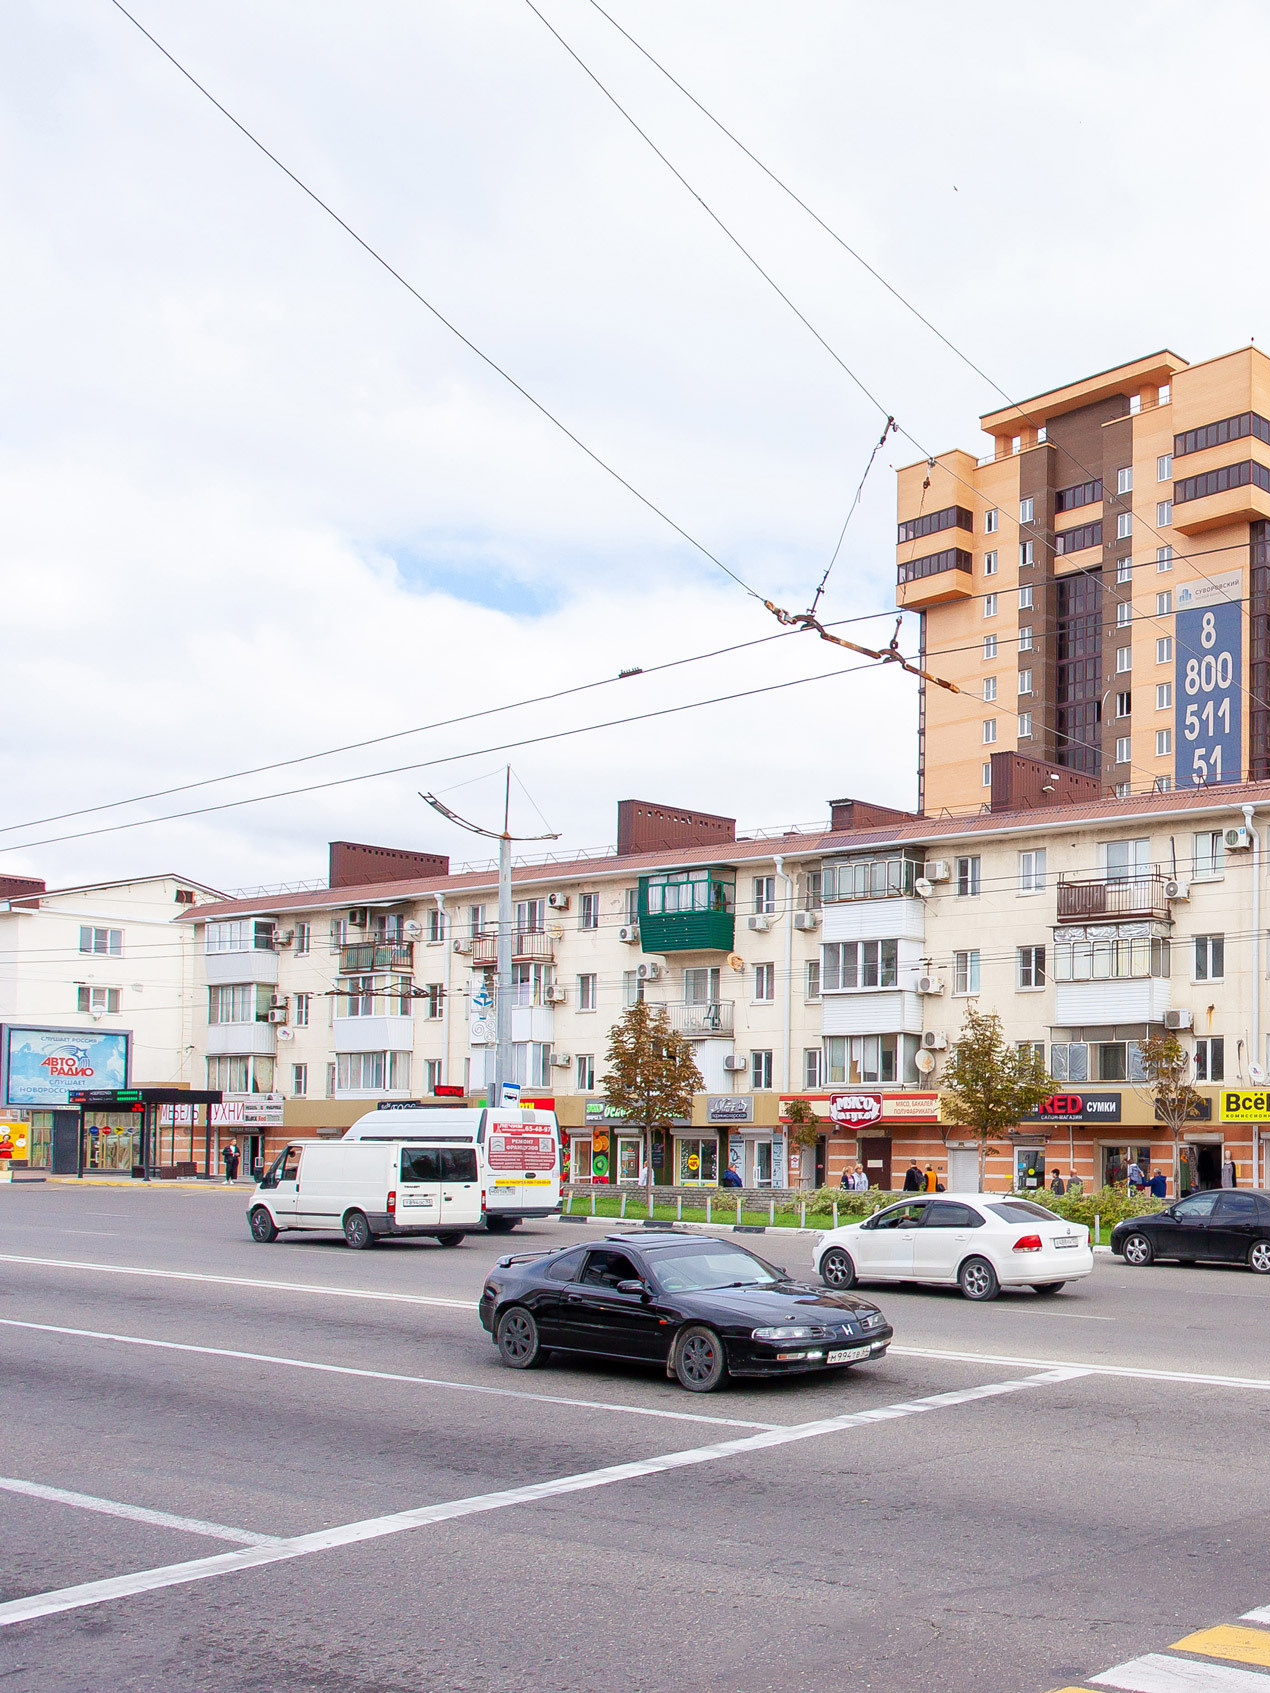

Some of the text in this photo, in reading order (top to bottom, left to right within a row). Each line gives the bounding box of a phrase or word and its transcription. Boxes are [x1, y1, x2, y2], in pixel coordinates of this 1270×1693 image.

[1201, 611, 1216, 649] 8
[1185, 651, 1232, 695] 800
[1184, 697, 1230, 741] 511
[1192, 745, 1222, 785] 51
[40, 1057, 76, 1067] АВТО
[50, 1067, 94, 1077] РАДИО
[211, 1103, 245, 1121] УХНИ
[1039, 1095, 1083, 1114] RED
[1086, 1102, 1116, 1112] СУМКИ
